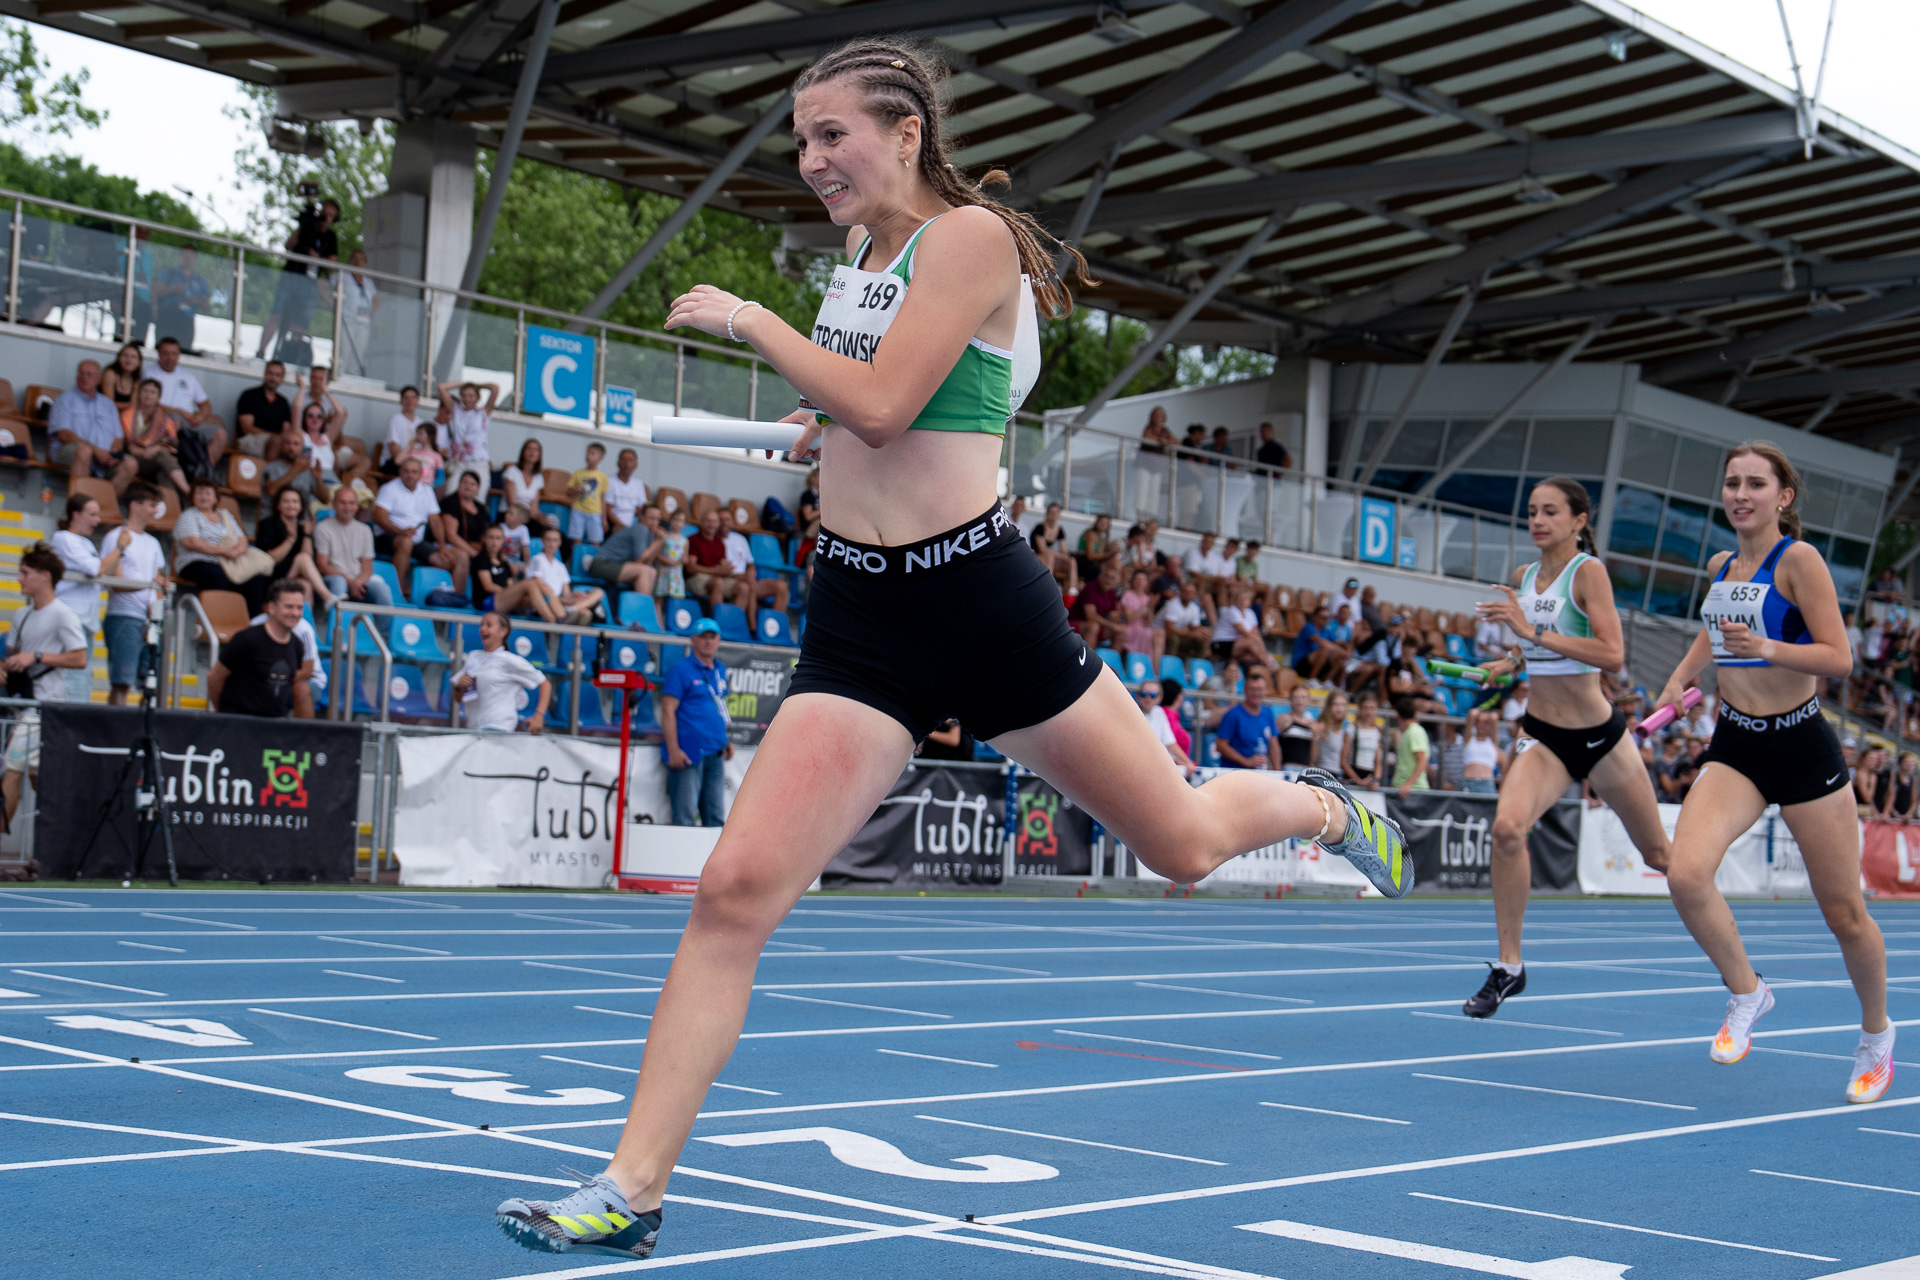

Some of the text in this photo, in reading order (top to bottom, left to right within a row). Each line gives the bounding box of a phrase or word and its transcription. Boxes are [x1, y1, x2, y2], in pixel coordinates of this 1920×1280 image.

[858, 282, 899, 311] 169
[539, 334, 582, 354] SEKTOR
[811, 324, 882, 365] TROWSK
[541, 354, 578, 412] C
[607, 390, 633, 413] WC
[827, 540, 887, 574] PRO
[905, 522, 991, 574] NIKE
[1365, 516, 1389, 557] D
[1535, 599, 1557, 613] 848
[1730, 586, 1761, 602] 653
[726, 667, 784, 697] runner
[1729, 709, 1768, 732] PRO
[1775, 699, 1818, 731] NIKE
[78, 744, 255, 807] ublin
[212, 812, 309, 831] INSPIRACJI
[1411, 813, 1493, 867] Lubli
[529, 851, 601, 868] MIASTO
[913, 861, 1058, 878] MIASTO INSRACJI
[45, 1015, 254, 1046] 4
[343, 1065, 625, 1106] 3
[692, 1126, 1059, 1183] 2
